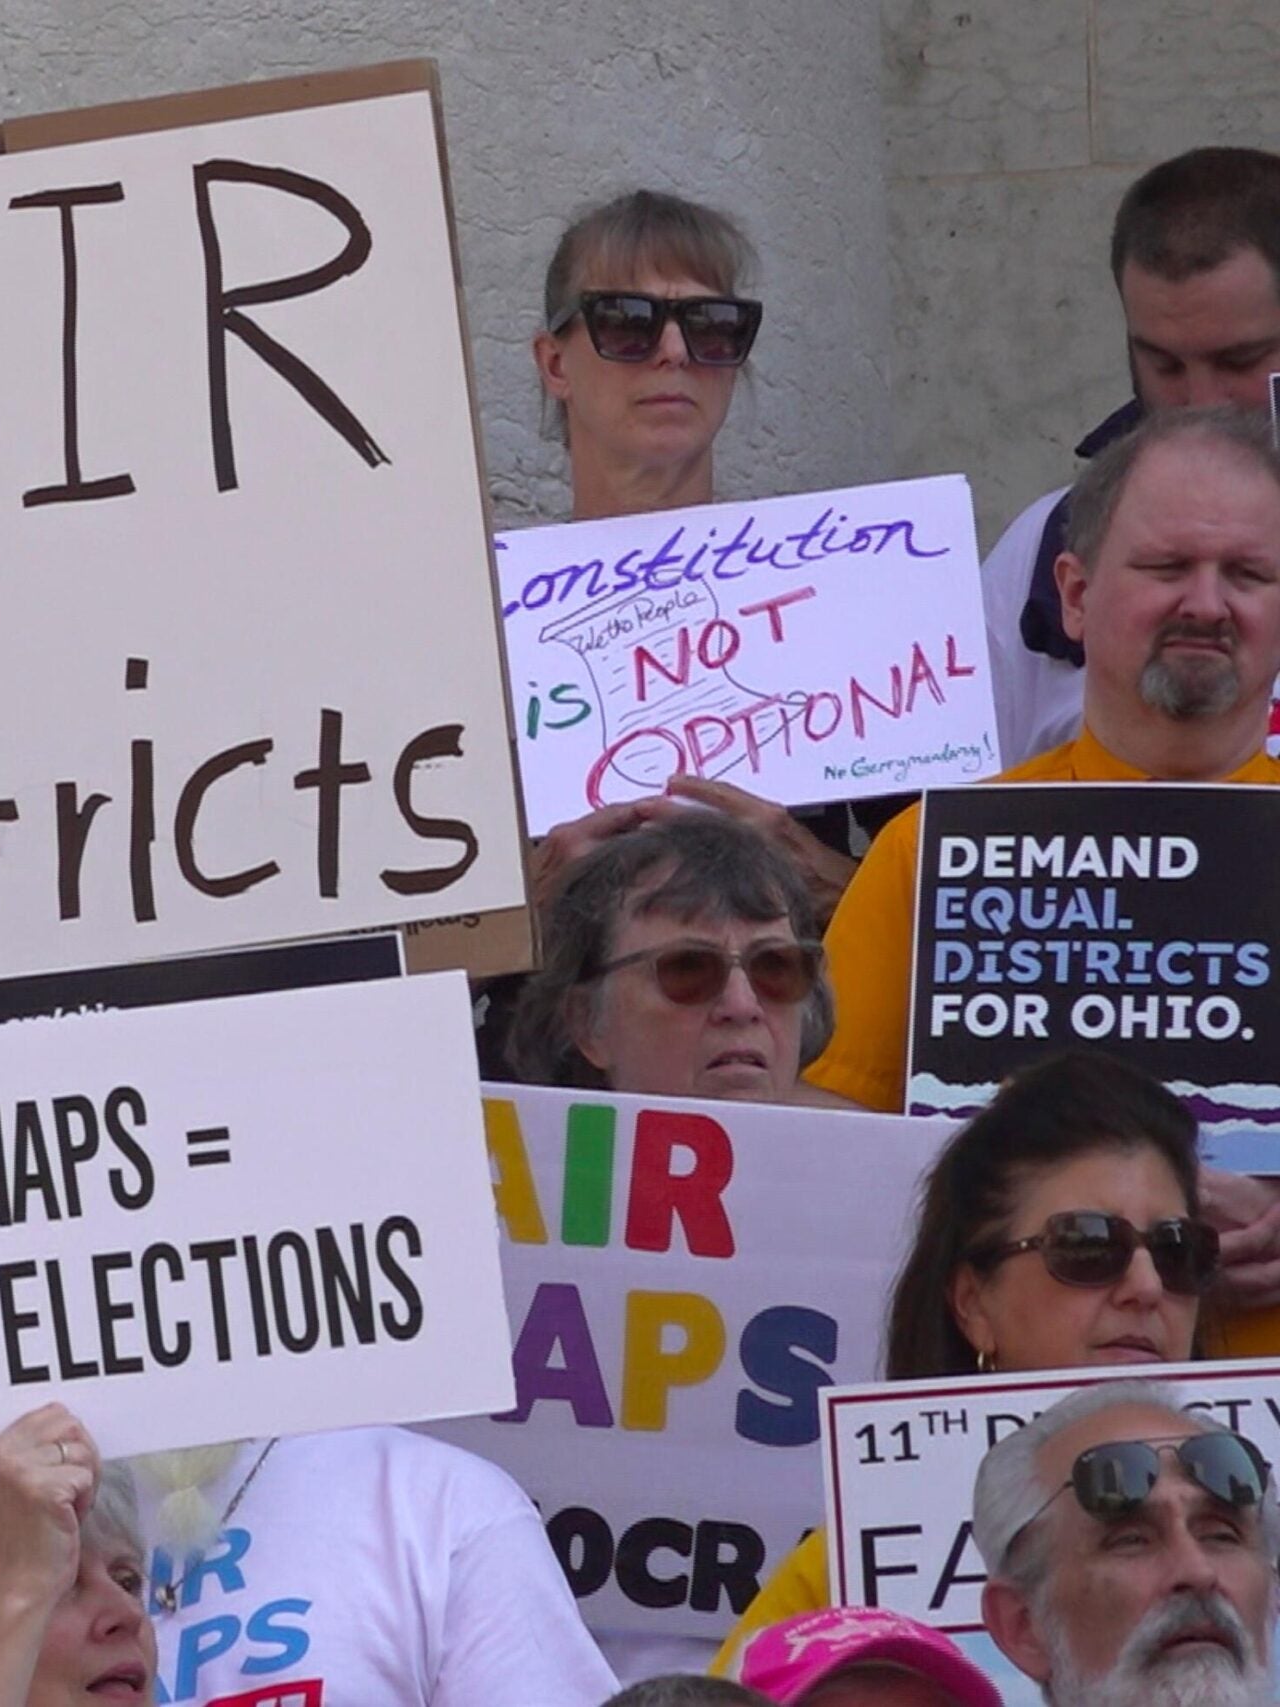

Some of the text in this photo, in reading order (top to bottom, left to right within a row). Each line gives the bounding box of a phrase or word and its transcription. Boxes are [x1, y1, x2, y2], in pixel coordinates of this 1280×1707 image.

[494, 507, 950, 618] onstitution
[526, 585, 816, 739] is NOT
[586, 634, 975, 812] OPTIONAL
[934, 887, 1134, 934] EQUAL
[938, 836, 1200, 880] DEMAND
[930, 994, 1255, 1041] FOR OHIO.
[933, 941, 1271, 987] DISTRICTS
[483, 1097, 736, 1259] AIR
[490, 1283, 838, 1447] APS
